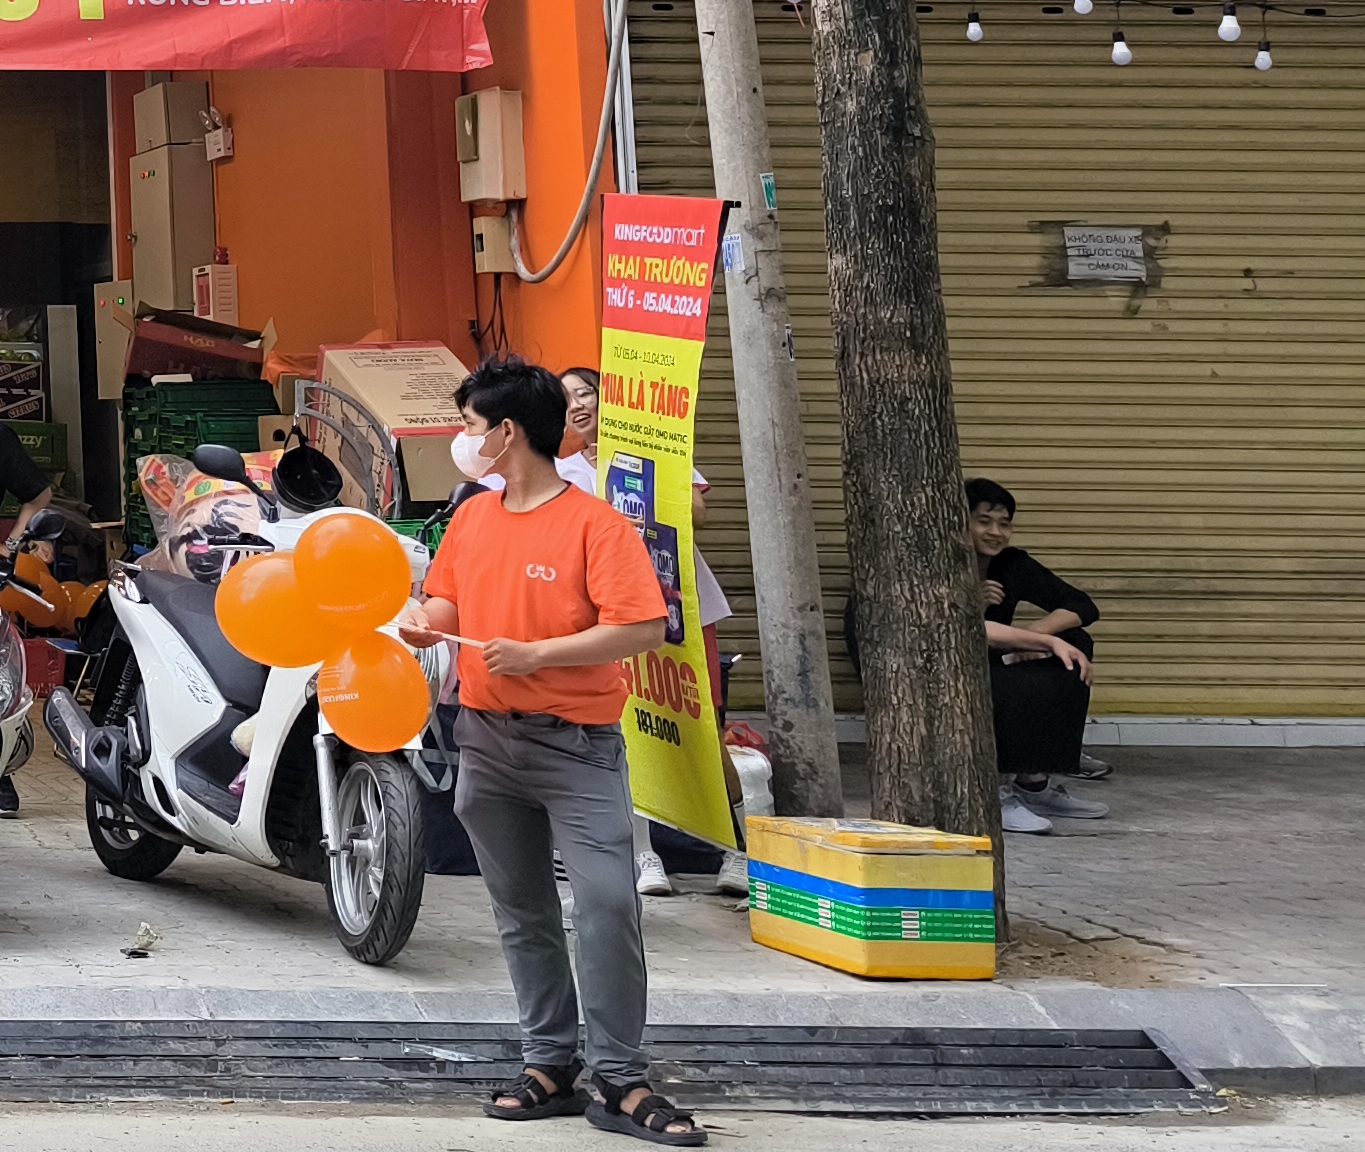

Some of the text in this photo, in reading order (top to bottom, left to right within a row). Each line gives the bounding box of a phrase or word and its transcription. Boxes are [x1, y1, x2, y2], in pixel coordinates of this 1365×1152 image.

[607, 253, 709, 288] KHAI TRƯƠNG
[605, 282, 702, 318] THỨ 6 05.04.2024
[600, 369, 690, 422] MUA LÀ TẶNG
